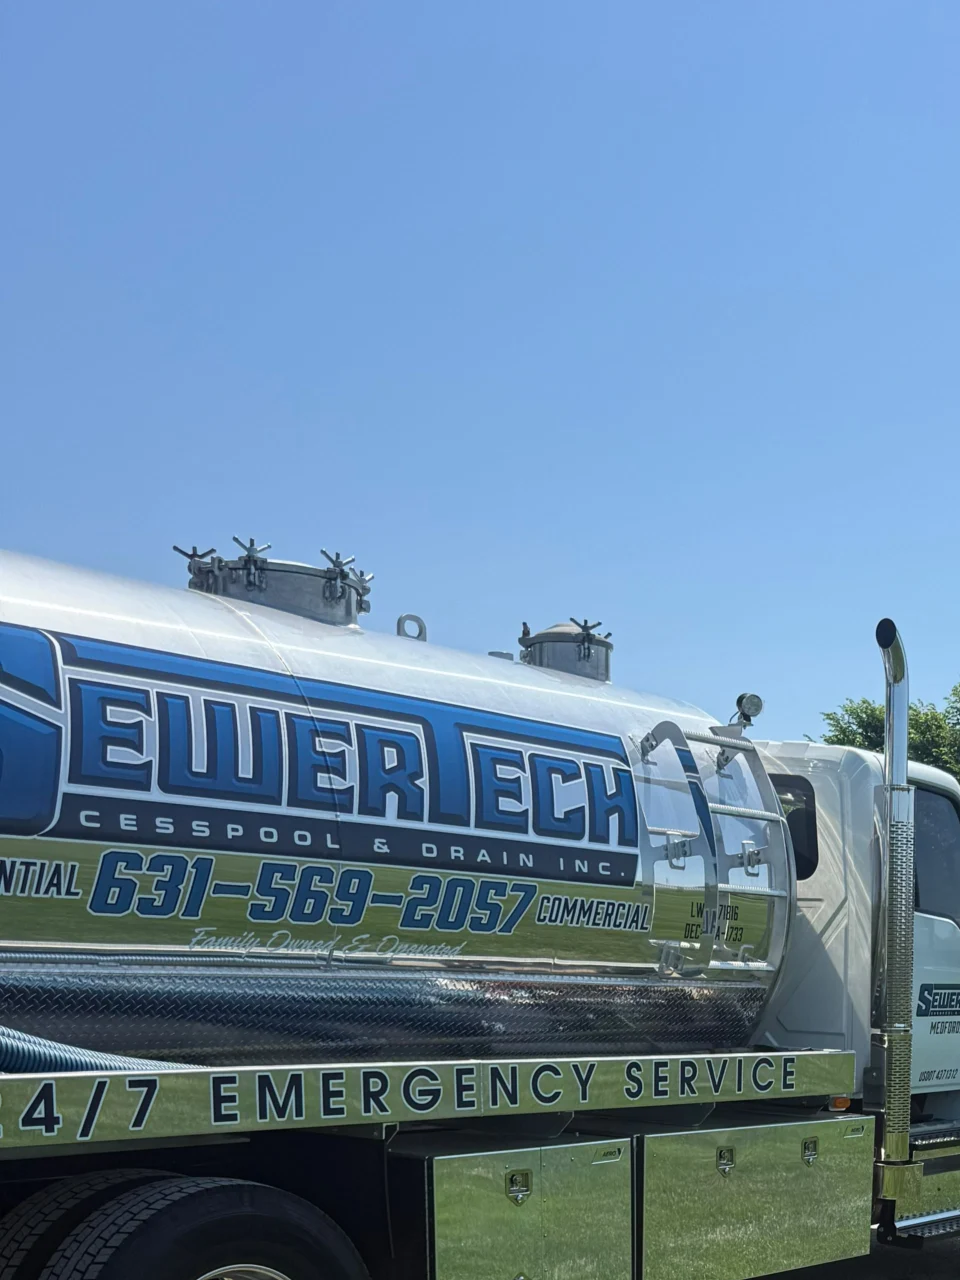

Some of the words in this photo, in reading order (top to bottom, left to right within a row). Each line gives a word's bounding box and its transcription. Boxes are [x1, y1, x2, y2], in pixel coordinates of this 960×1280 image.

[79, 810, 341, 849] CESSPOOL
[373, 838, 390, 853] &
[422, 843, 534, 868] DRAIN
[559, 857, 625, 877] INC.
[87, 848, 538, 934] 631-569-2057
[536, 895, 650, 932] COMMERCIAL
[189, 927, 260, 959] Family
[266, 930, 342, 952] Owned
[0, 1076, 160, 1140] 4/7
[210, 1062, 598, 1125] EMERGENCY
[624, 1056, 797, 1100] SERVICE
